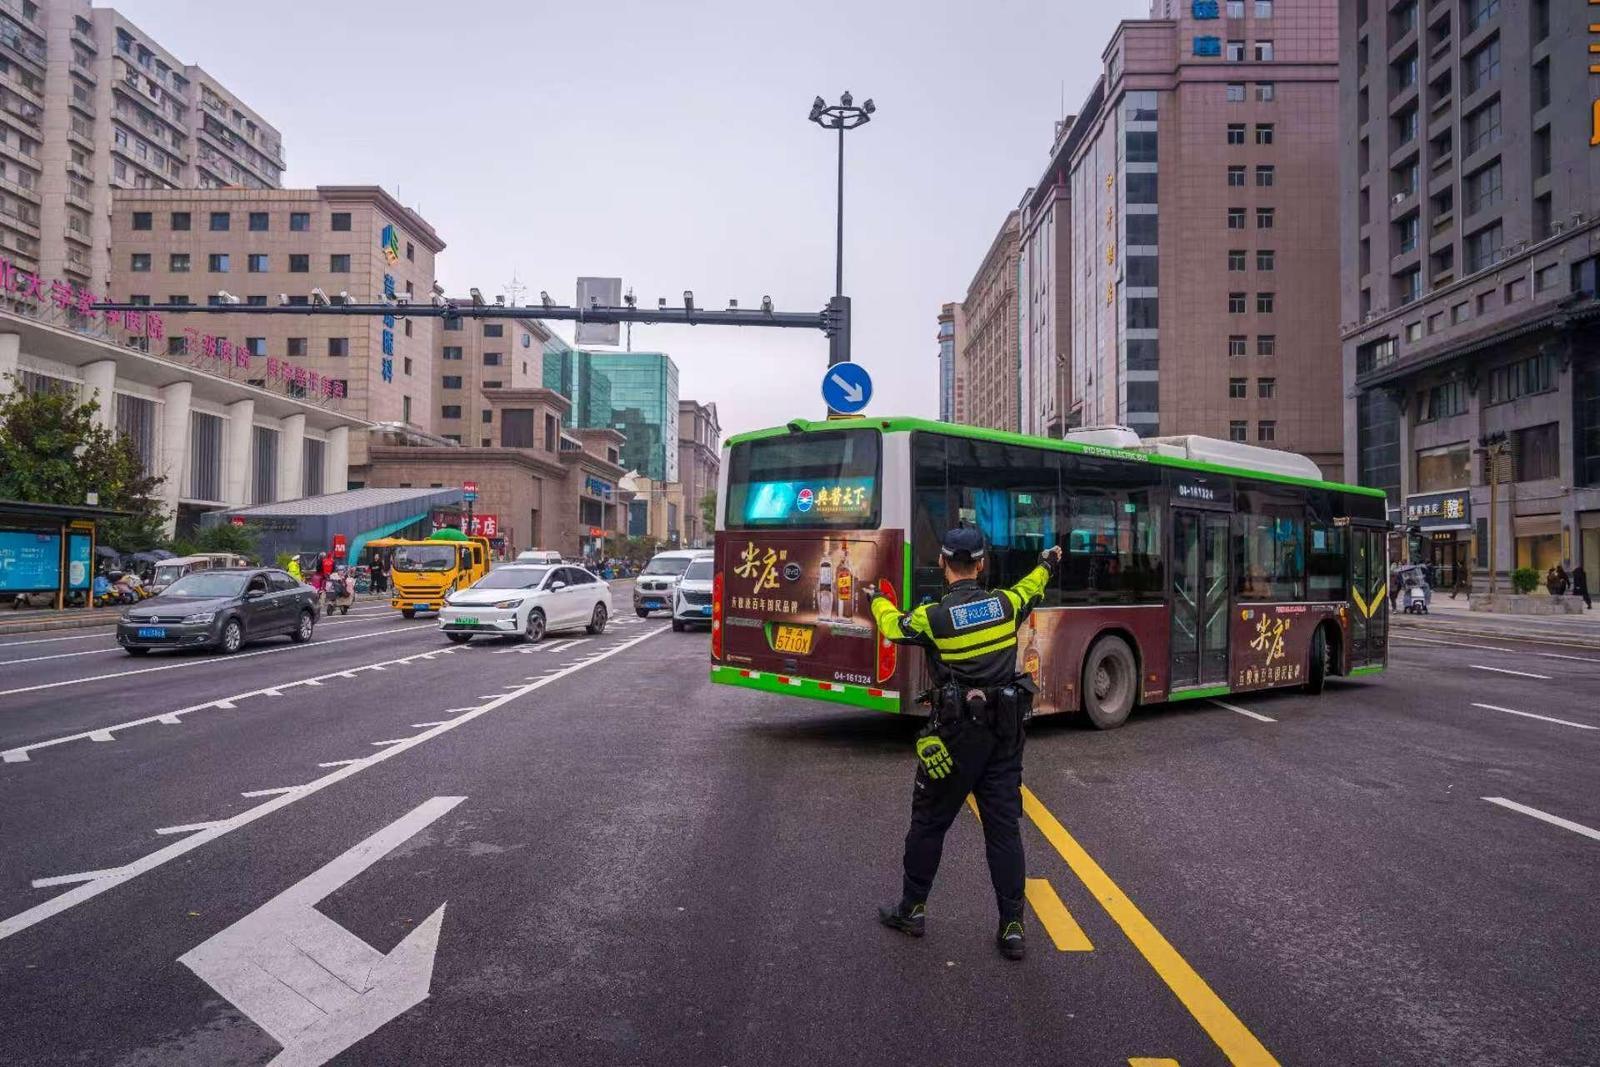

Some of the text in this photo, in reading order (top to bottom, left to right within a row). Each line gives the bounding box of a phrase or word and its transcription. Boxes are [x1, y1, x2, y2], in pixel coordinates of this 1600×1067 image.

[733, 541, 780, 595] 尖庄
[954, 601, 1001, 625] 警 POLICE 察
[1249, 612, 1286, 666] 尖庄
[834, 673, 872, 685] 04-161324
